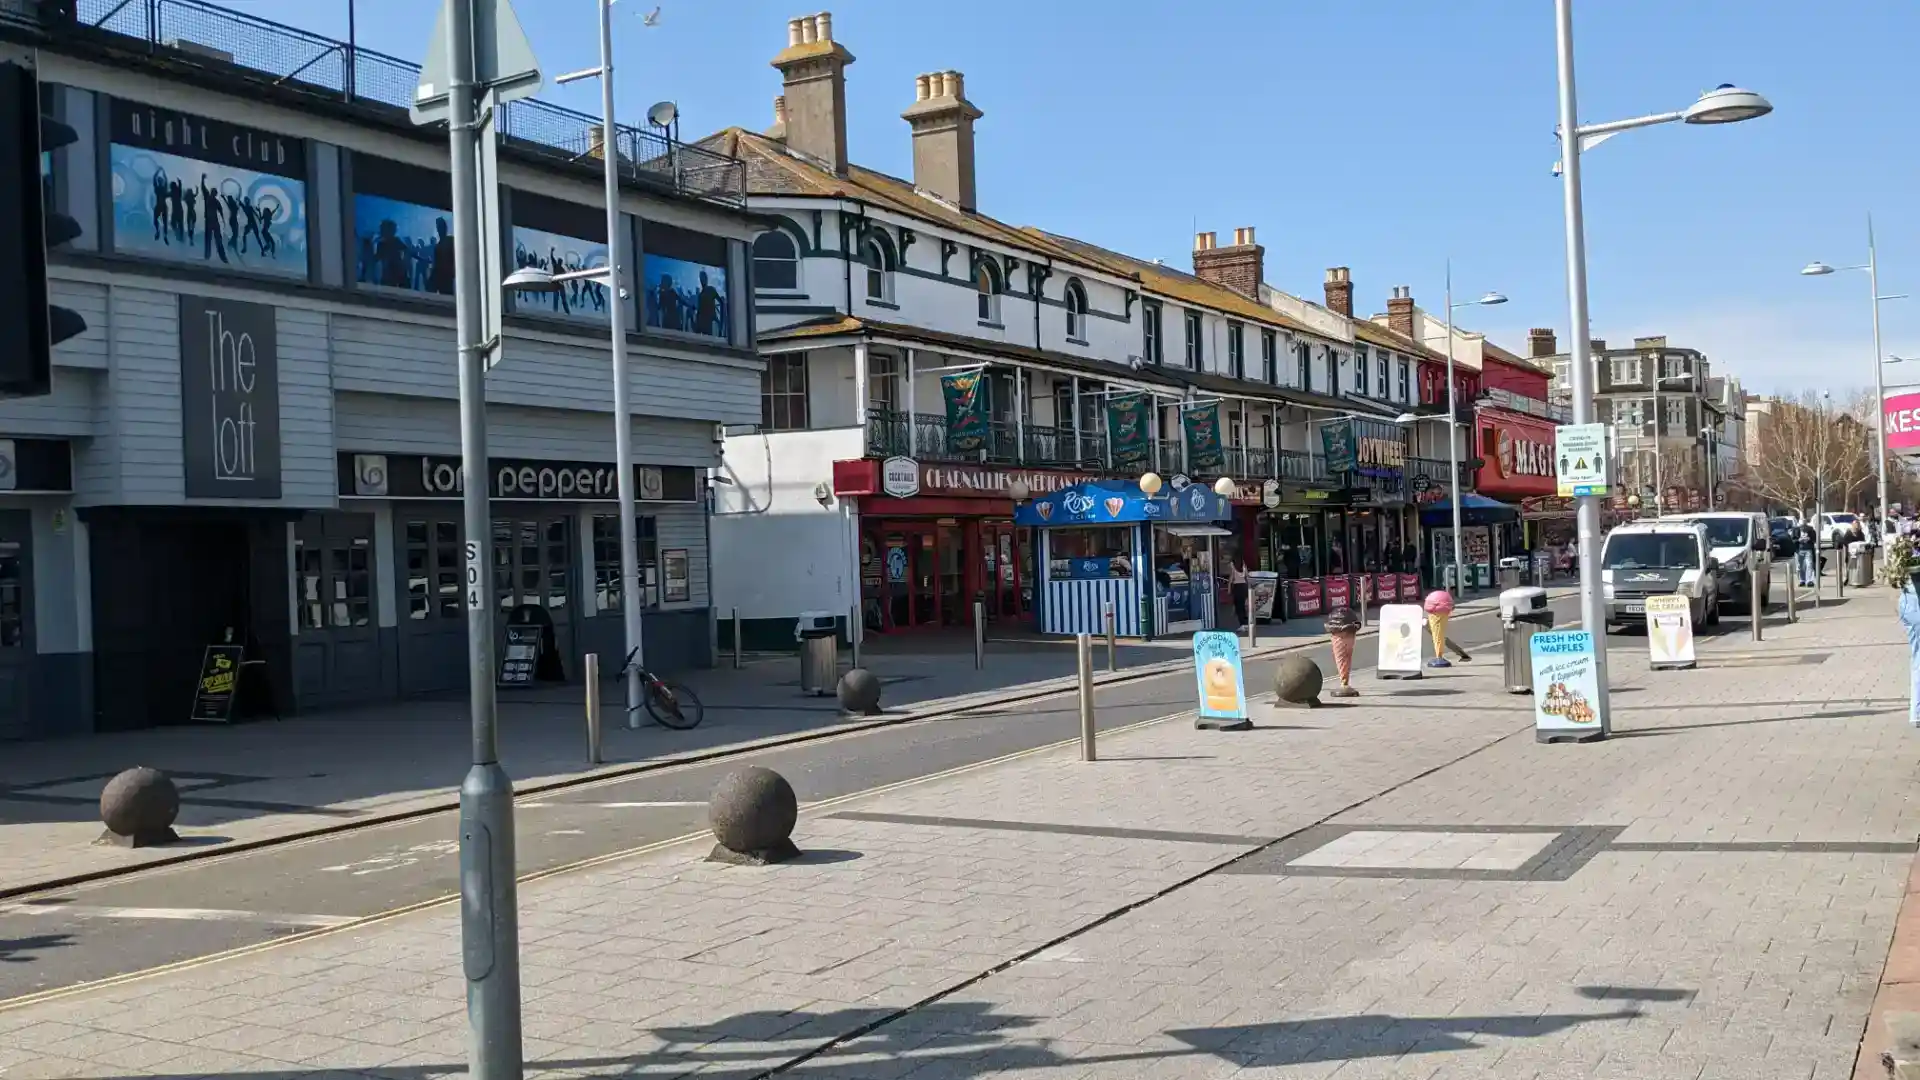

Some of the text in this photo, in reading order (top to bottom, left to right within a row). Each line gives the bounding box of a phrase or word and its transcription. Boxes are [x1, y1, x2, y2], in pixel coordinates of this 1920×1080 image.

[131, 109, 286, 165] night club
[204, 309, 256, 393] The
[1884, 407, 1920, 434] KES
[1514, 439, 1554, 477] MAGI
[498, 465, 615, 498] peppers
[1533, 632, 1590, 645] FRESH HOT
[1540, 642, 1585, 653] WAFFLES
